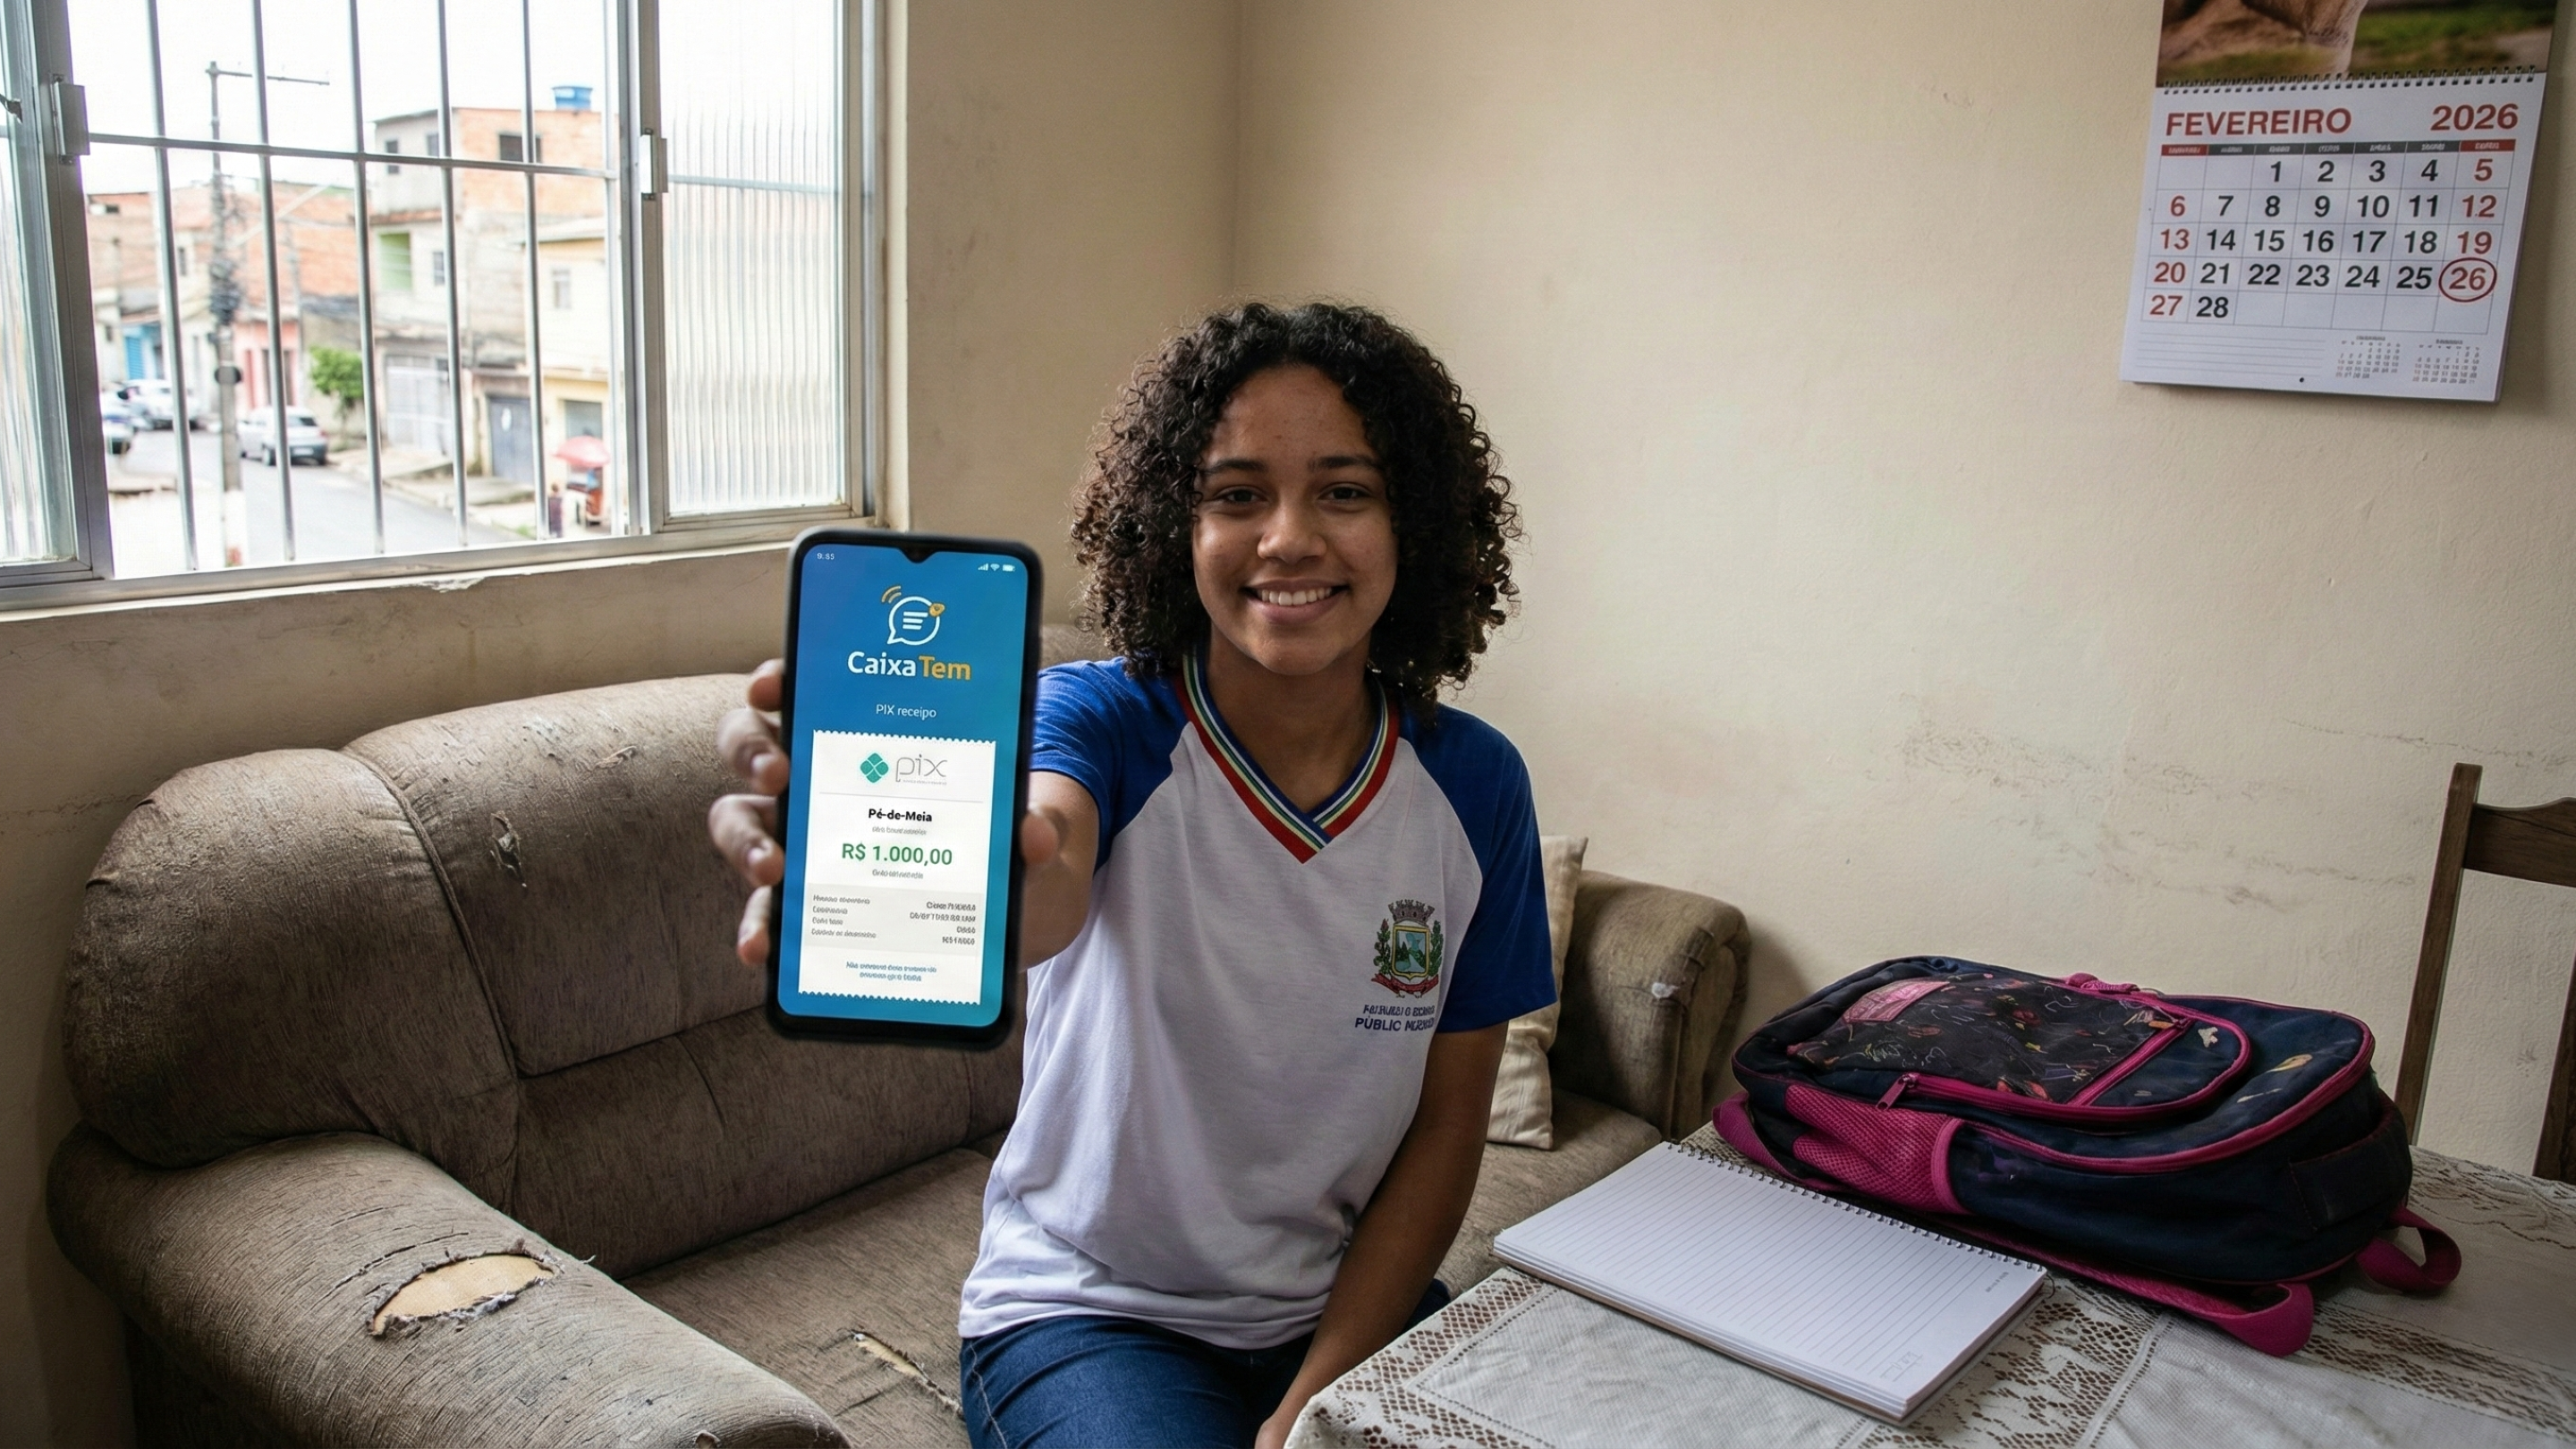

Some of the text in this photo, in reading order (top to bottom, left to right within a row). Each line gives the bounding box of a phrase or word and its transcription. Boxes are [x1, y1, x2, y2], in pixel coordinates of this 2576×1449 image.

[2165, 103, 2519, 137] FEVEREIRO 2026
[2270, 158, 2494, 182] 1 2 3 4 5
[2170, 194, 2497, 218] 6 7 8 9 10 11 12
[2160, 228, 2493, 255] 13 14 15 16 17 18 19
[2153, 261, 2487, 292] 20 21 22 23 24 25 26
[2149, 294, 2229, 318] 27 28
[847, 651, 972, 681] Caixa Tem
[876, 704, 937, 720] PIX receipo
[895, 753, 948, 783] pix
[868, 808, 933, 822] Pé-de-Meia
[841, 843, 953, 867] R$ 1.000,00
[1354, 1014, 1402, 1031] PÚBLIC
